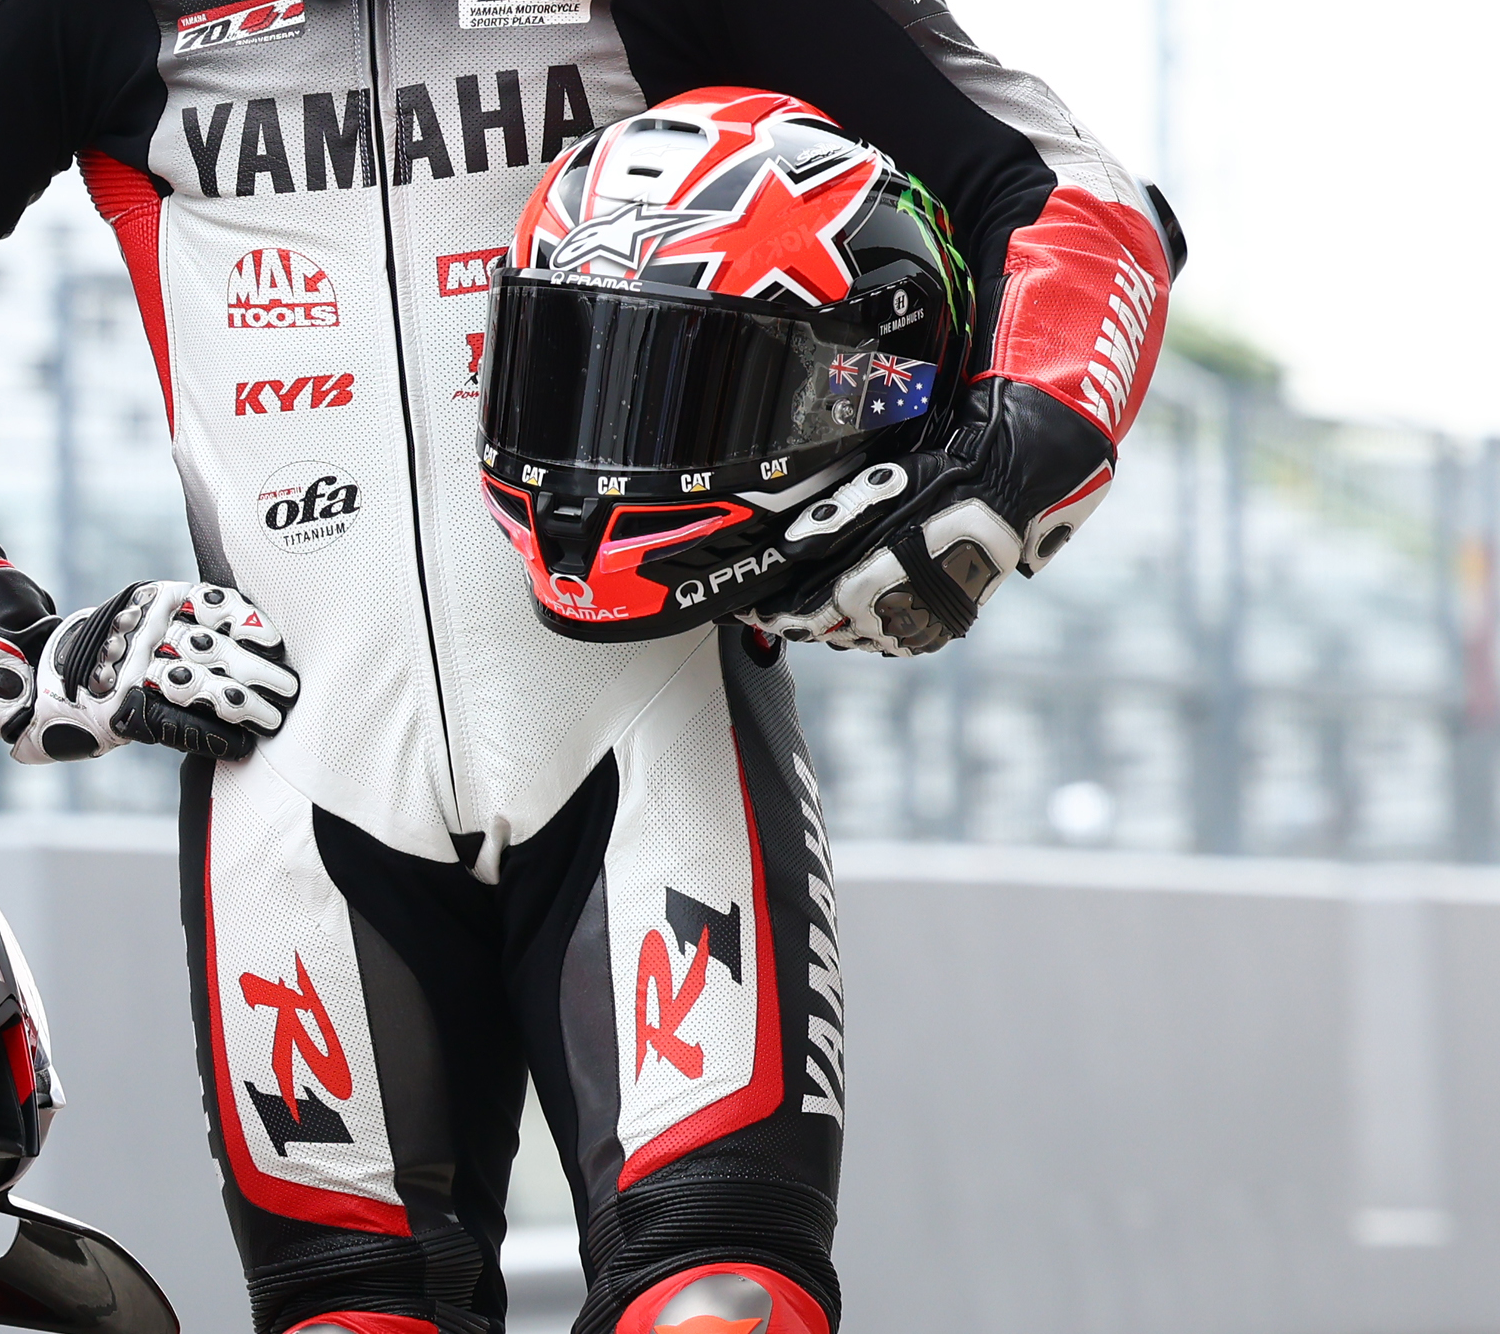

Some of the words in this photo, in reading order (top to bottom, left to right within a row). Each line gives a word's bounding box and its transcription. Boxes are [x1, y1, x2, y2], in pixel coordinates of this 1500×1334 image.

[180, 12, 208, 26] YAMAHA
[469, 5, 513, 18] YAMAHA
[514, 2, 581, 16] MOTORCYCLE
[470, 16, 510, 28] SPORTS
[511, 15, 546, 27] PLAZA
[235, 29, 300, 46] ANNIVERSARY
[182, 63, 595, 199] YAMAHA
[228, 247, 337, 306] MAC
[566, 272, 643, 294] PRAMAC
[229, 304, 339, 328] TOOLS
[879, 322, 891, 336] THE
[891, 318, 905, 331] MAD
[234, 372, 356, 417] KYB
[483, 443, 499, 468] CAT
[760, 455, 789, 480] CAT
[521, 464, 547, 486] CAT
[598, 475, 628, 496] CAT
[681, 471, 712, 493] CAT
[264, 475, 361, 531] ofa
[282, 522, 348, 548] TITANIUM
[635, 885, 743, 1086] R1
[239, 947, 356, 1159] R1
